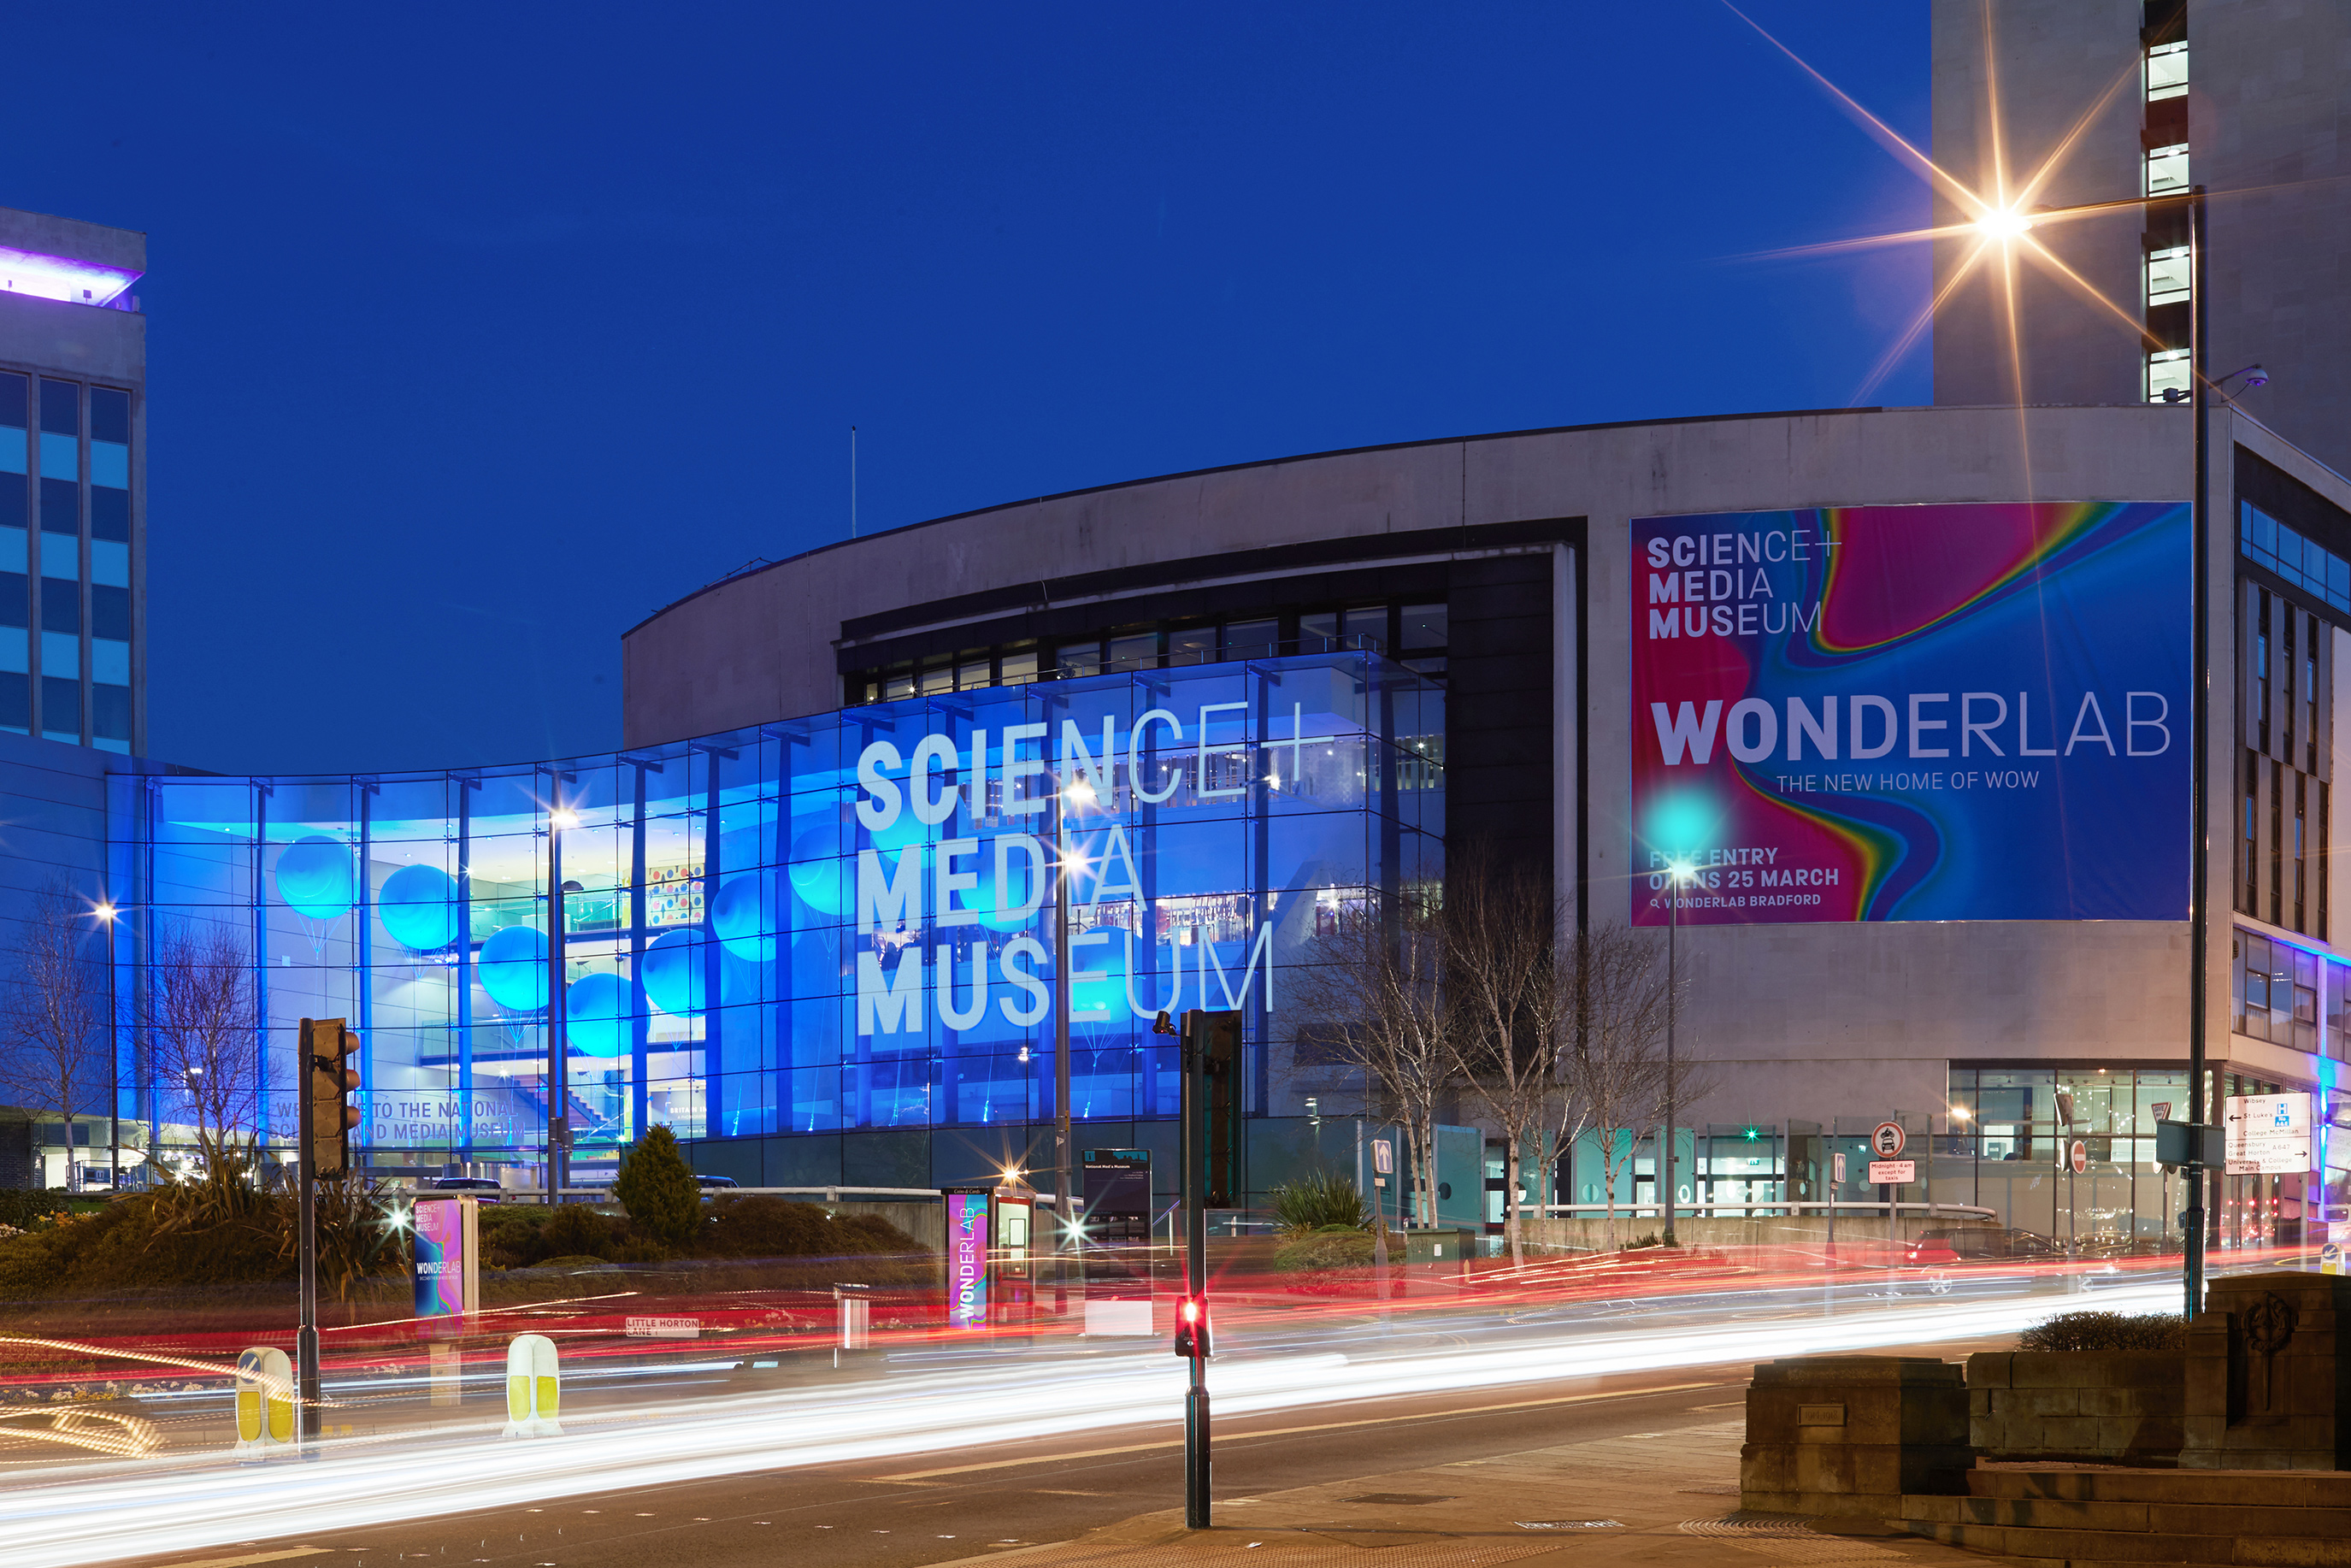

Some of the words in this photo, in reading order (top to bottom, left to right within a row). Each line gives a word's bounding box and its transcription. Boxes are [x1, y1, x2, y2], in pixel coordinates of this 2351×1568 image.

[1647, 529, 1841, 569] SCIENCE+
[1649, 568, 1773, 604] MEDIA
[1649, 601, 1821, 640] MUSEUM
[1651, 691, 2171, 765] WONDERLAB
[855, 701, 1335, 832] SCIENCE+
[1777, 775, 1816, 793] THE
[1824, 773, 1872, 792] NEW
[1880, 772, 1943, 791] HOME
[1951, 771, 1978, 789] OF
[1984, 770, 2039, 789] WOW
[1710, 847, 1778, 866] ENTRY
[857, 823, 1147, 934] MEDIA
[1728, 870, 1753, 887] 25
[1761, 869, 1839, 887] MARCH
[1750, 894, 1821, 906] BRADFORD
[857, 920, 1273, 1035] MUSEUM
[373, 1102, 392, 1117] TO
[399, 1101, 431, 1117] THE
[439, 1100, 518, 1117] NATIONAL
[351, 1123, 386, 1139] AND
[394, 1123, 448, 1139] MEDIA
[455, 1122, 526, 1139] MUSEUM
[415, 1214, 433, 1223] MEDIA
[415, 1223, 439, 1231] MUSEUM
[416, 1260, 461, 1274] WONDERLAB
[960, 1207, 975, 1319] WONDERLAB
[659, 1319, 698, 1328] HORTON
